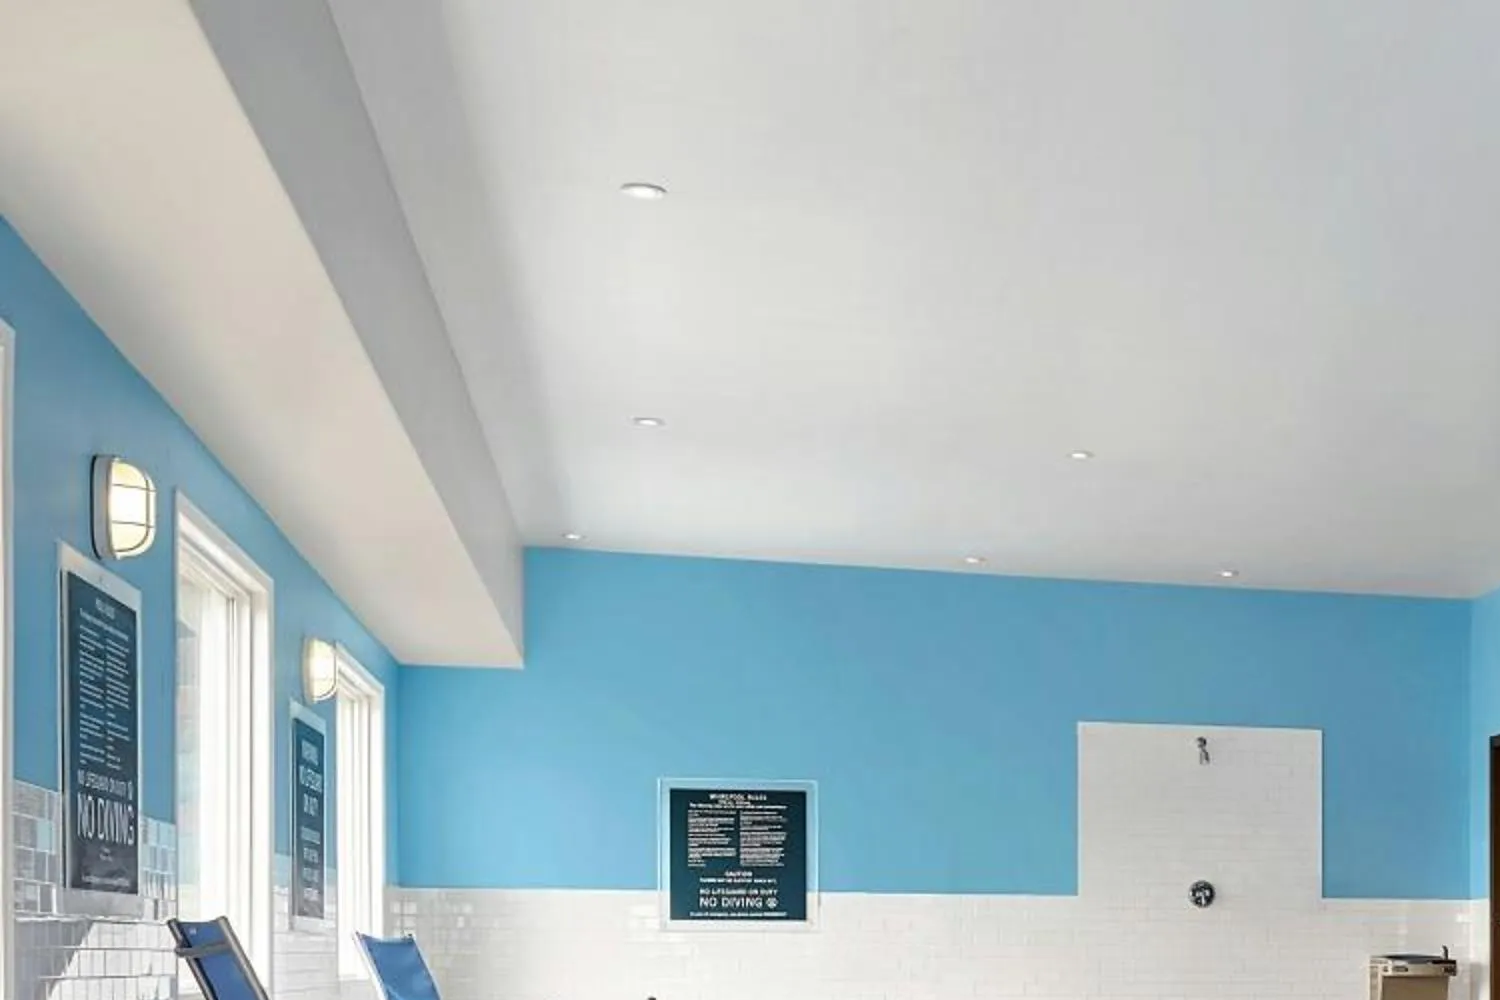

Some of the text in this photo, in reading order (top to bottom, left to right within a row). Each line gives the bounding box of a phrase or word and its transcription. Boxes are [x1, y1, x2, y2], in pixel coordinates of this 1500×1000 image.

[77, 793, 134, 846] NO DIVING
[699, 897, 763, 909] NO DIVING
